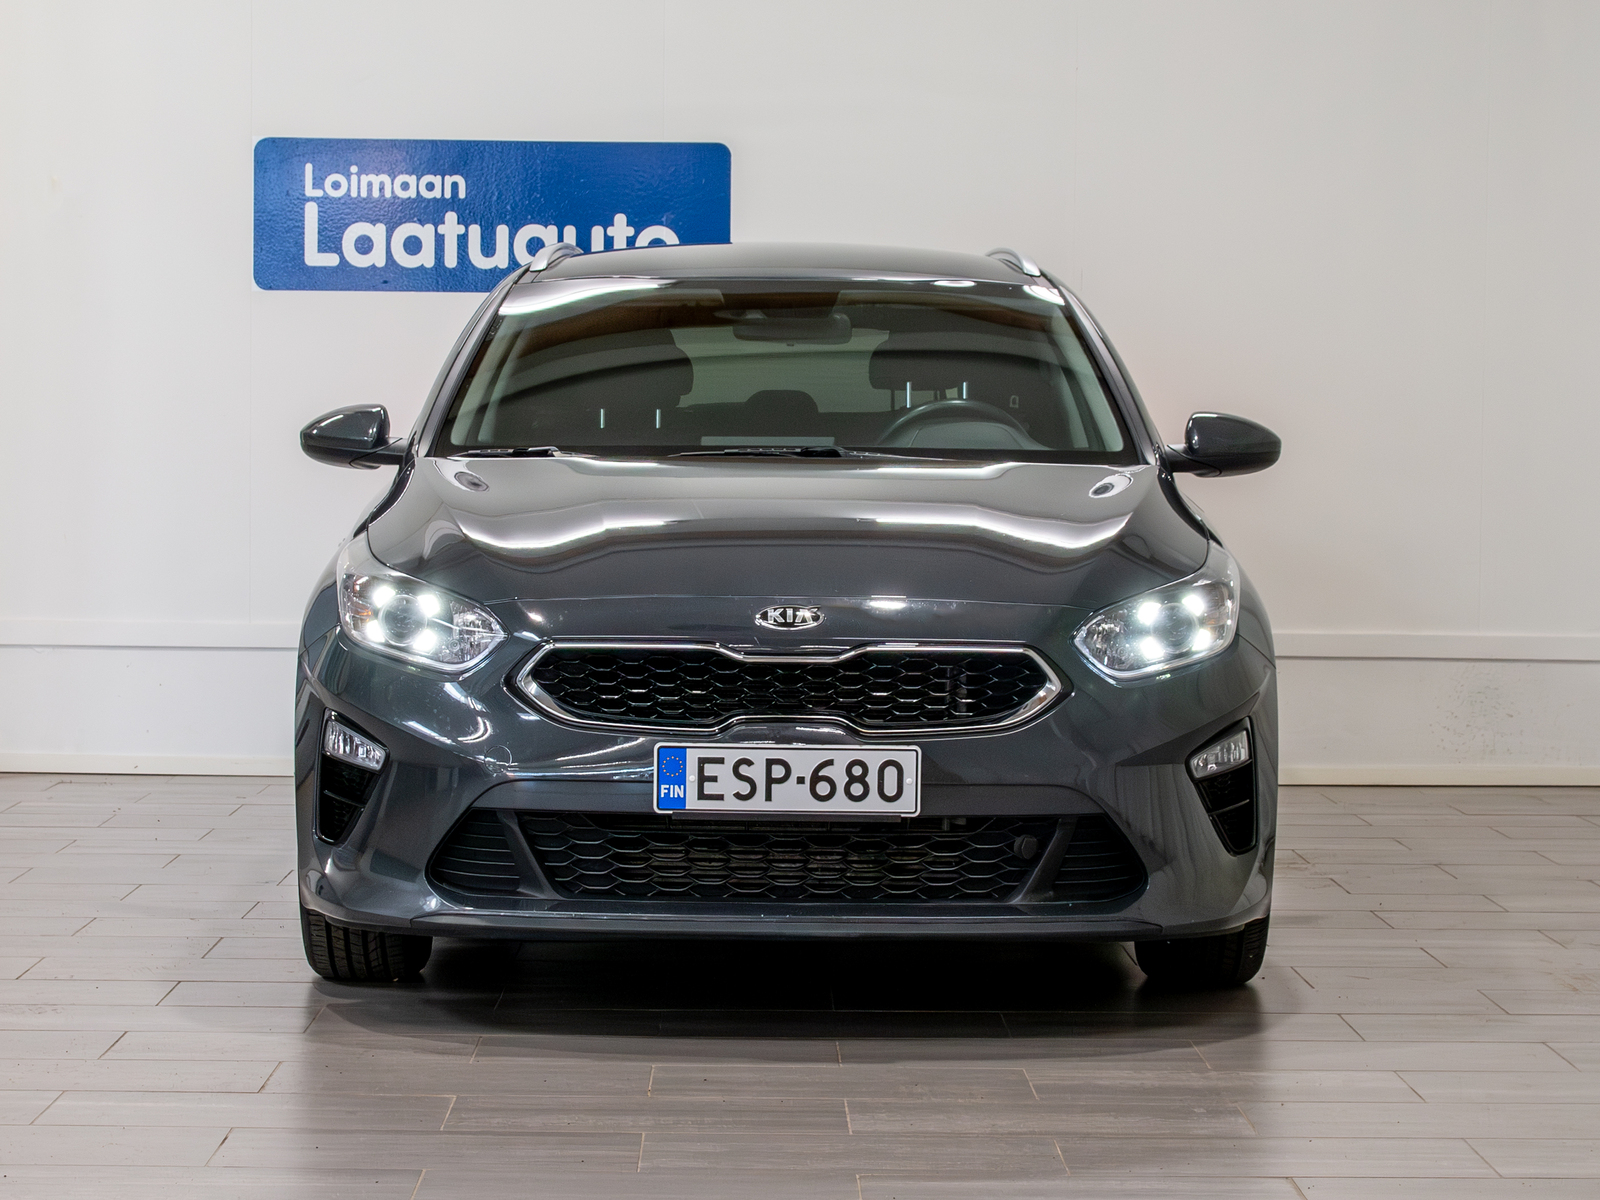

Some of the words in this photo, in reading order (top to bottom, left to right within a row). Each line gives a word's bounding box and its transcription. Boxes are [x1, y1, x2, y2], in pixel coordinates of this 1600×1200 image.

[304, 163, 466, 199] Loimaan
[767, 607, 815, 623] KIA
[660, 784, 684, 798] FIN
[697, 756, 904, 803] ESP-680
